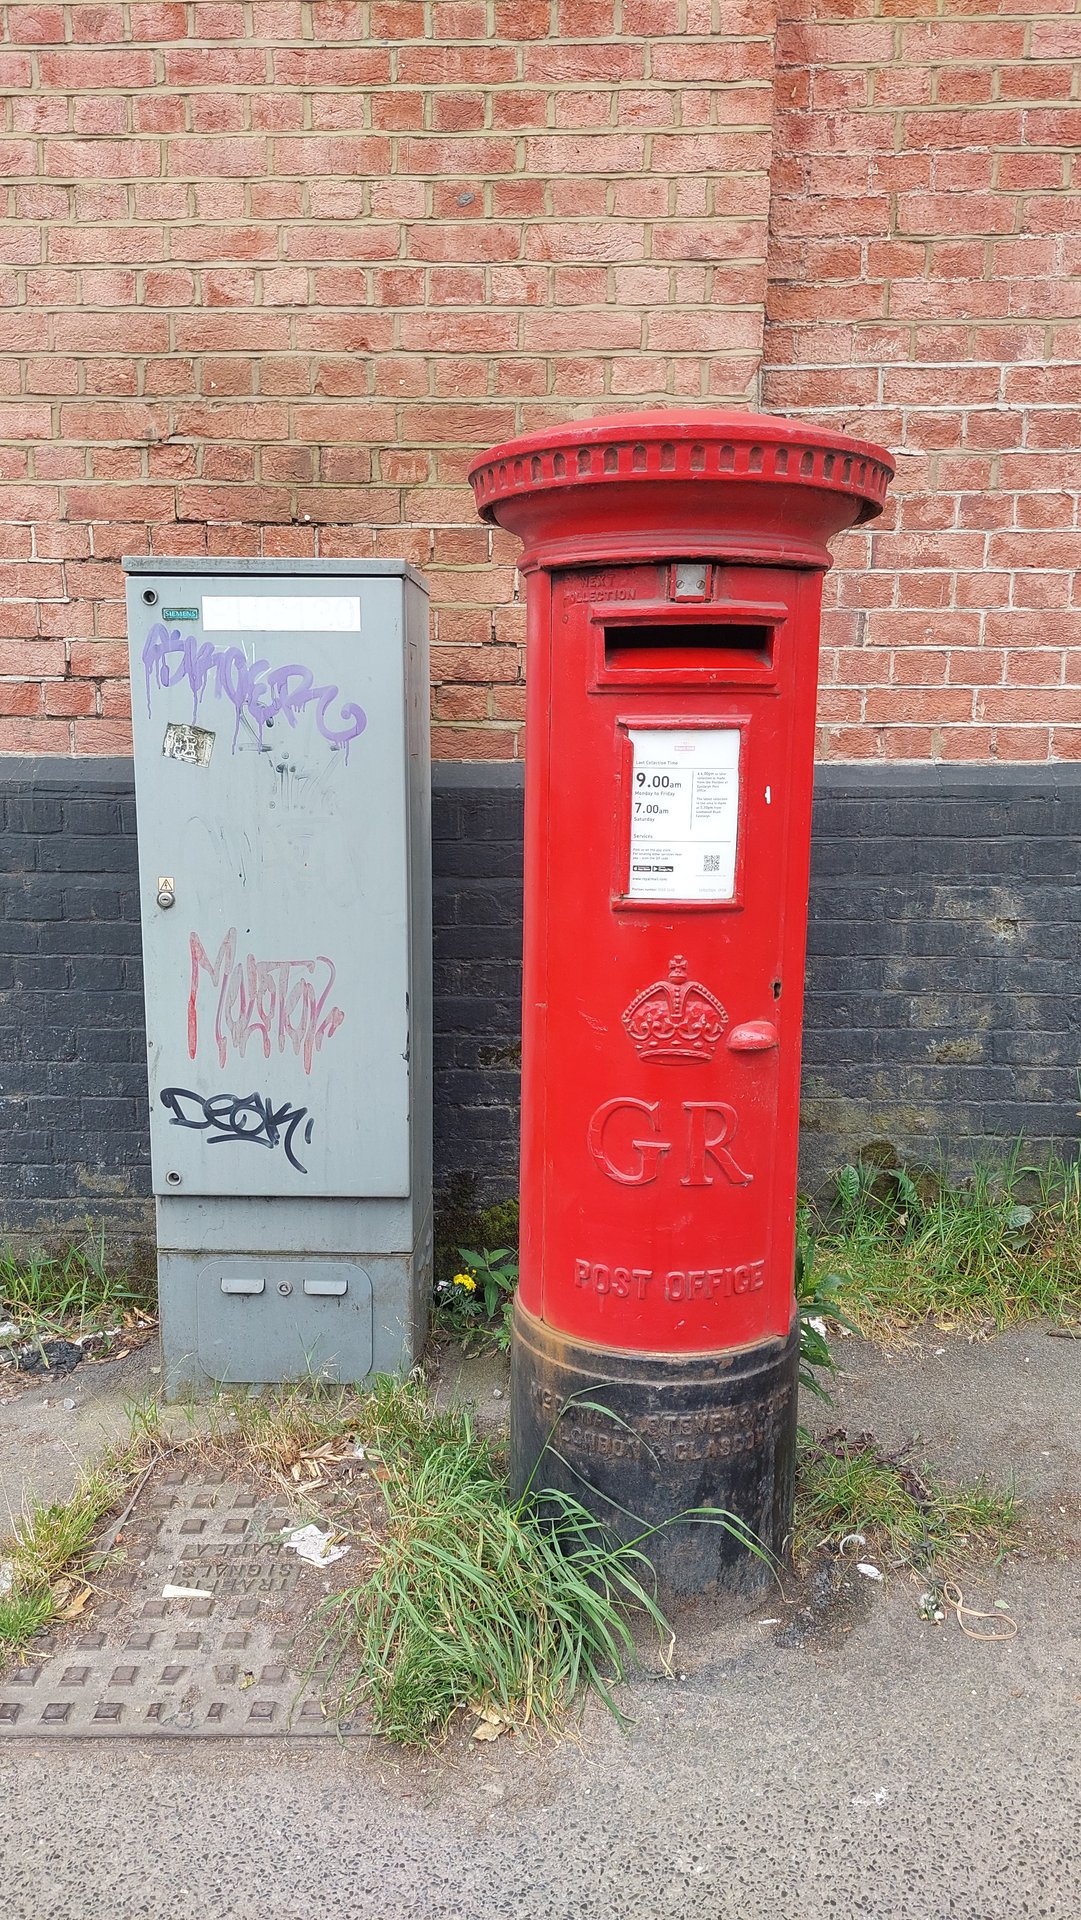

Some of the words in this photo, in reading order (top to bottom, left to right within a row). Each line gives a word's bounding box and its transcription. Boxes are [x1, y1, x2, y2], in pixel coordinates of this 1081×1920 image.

[580, 573, 616, 588] NEXT
[636, 772, 682, 788] 9.00am
[635, 802, 669, 814] 7.00am
[587, 1096, 754, 1187] GR
[575, 1258, 652, 1299] POST
[665, 1258, 765, 1302] OFFICE
[214, 1542, 297, 1556] GRADE
[182, 1563, 292, 1578] SIGNALS
